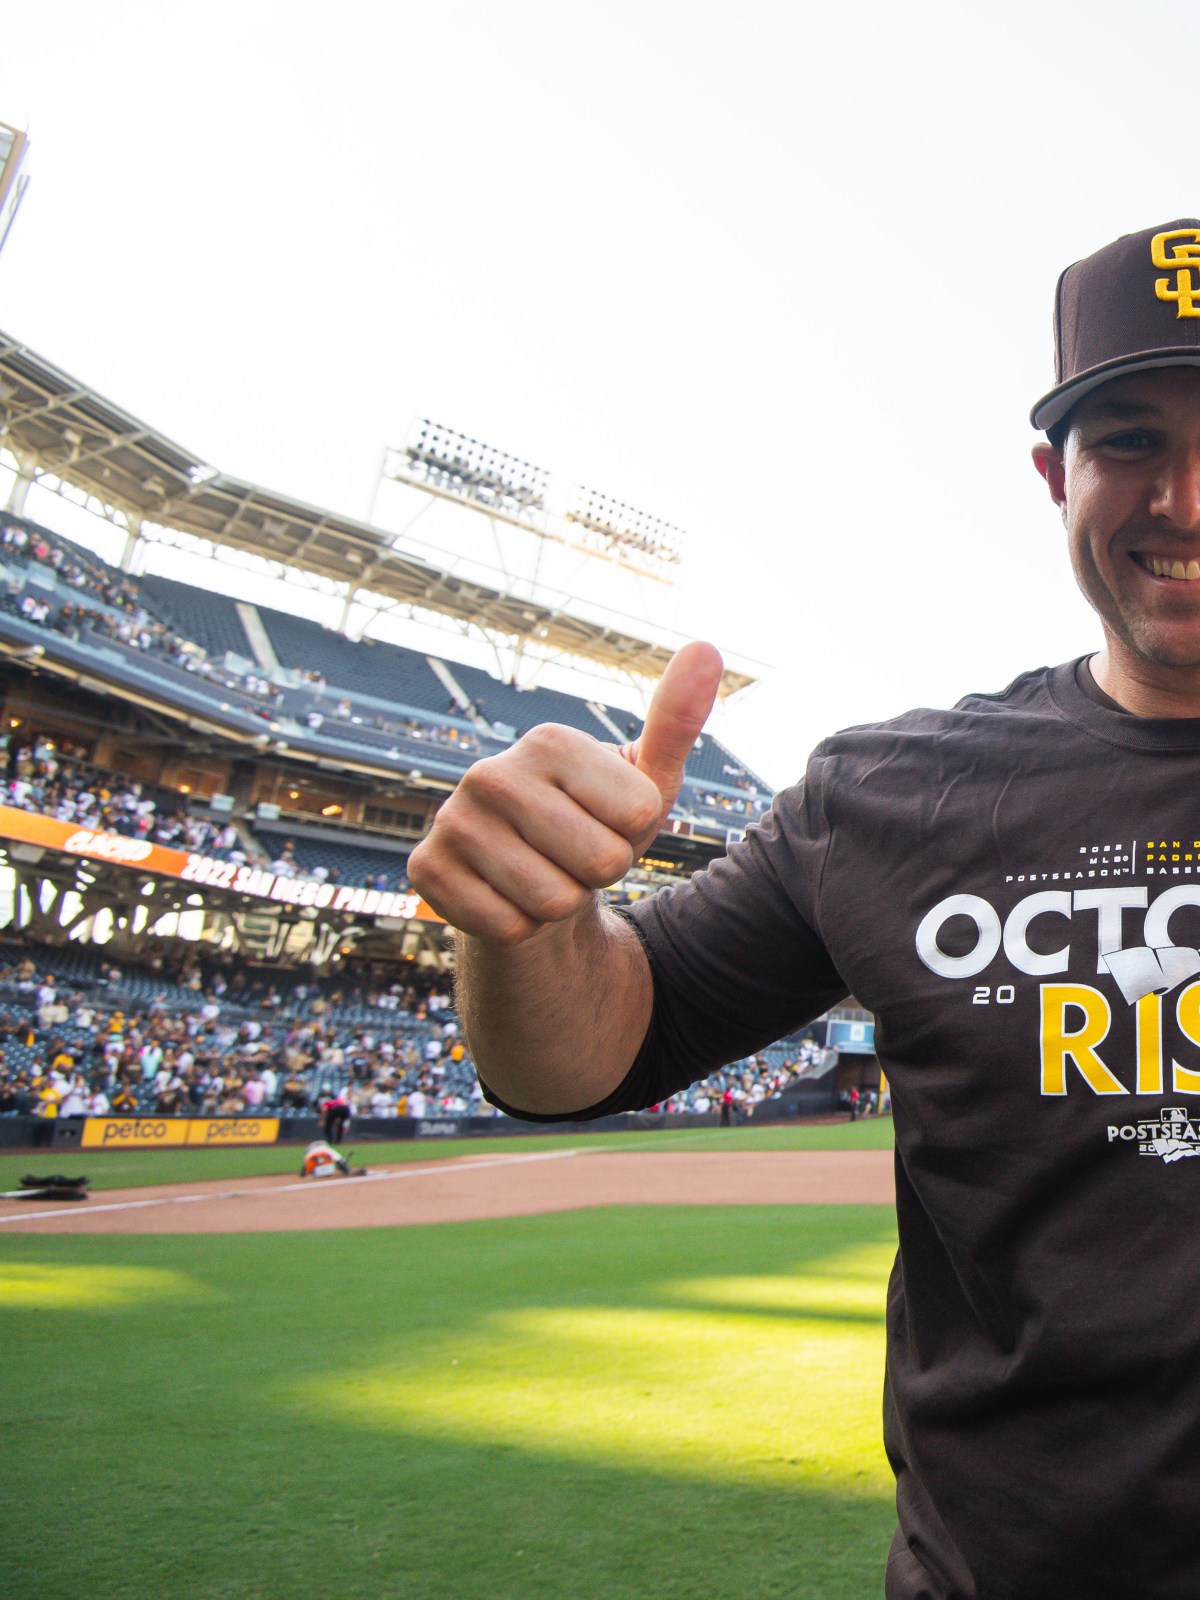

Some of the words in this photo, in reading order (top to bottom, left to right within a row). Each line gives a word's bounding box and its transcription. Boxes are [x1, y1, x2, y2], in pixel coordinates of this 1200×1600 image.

[1079, 843, 1122, 854] 2022
[1146, 841, 1180, 849] SAN
[181, 854, 236, 887] 2022
[234, 867, 275, 896] SAN
[334, 887, 419, 918] PADRES
[972, 985, 1015, 1005] 20
[102, 1119, 168, 1145] petco
[205, 1119, 261, 1143] petco
